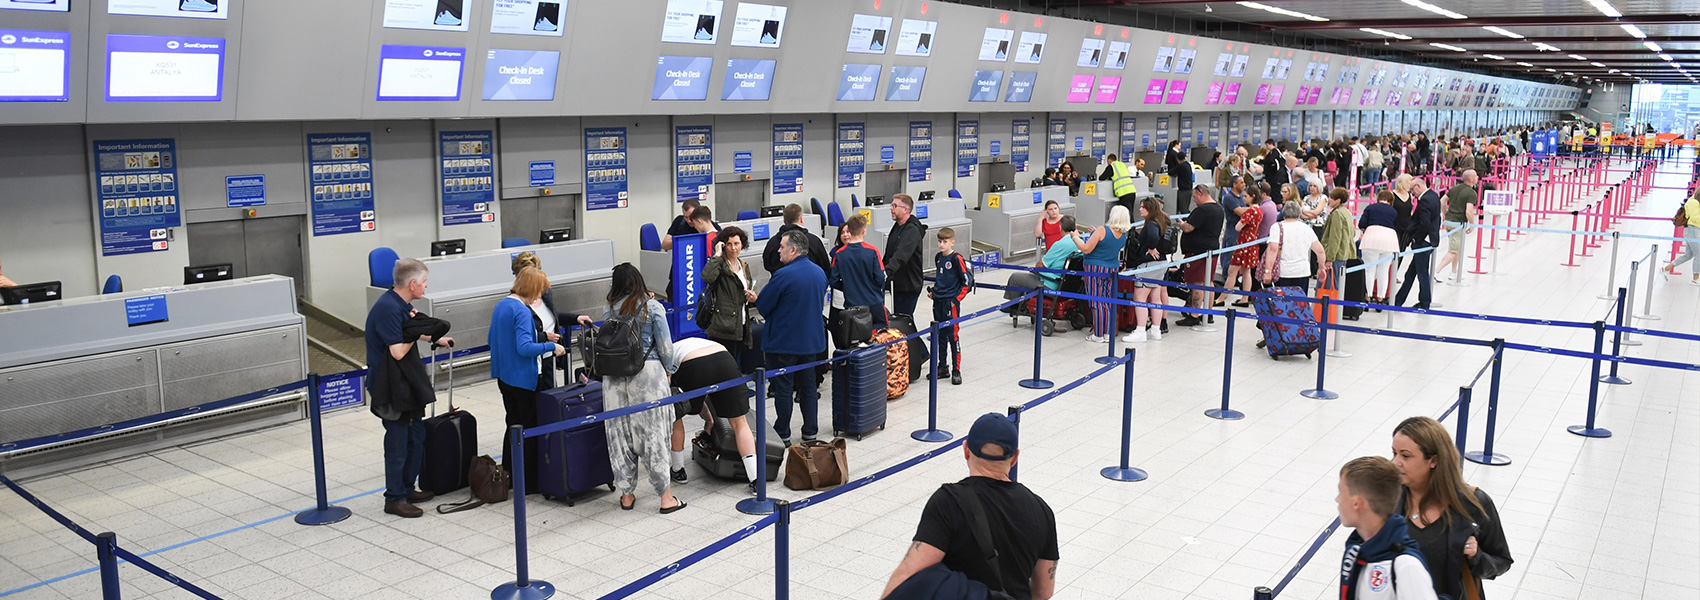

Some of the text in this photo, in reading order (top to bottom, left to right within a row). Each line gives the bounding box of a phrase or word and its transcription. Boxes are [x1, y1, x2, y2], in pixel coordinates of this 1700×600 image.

[921, 3, 928, 15] 9
[22, 37, 64, 45] SunExpress
[499, 65, 545, 75] Check-in Desk
[666, 70, 700, 78] Check-in Desk
[509, 76, 532, 85] Closed
[327, 379, 349, 387] NOTICE
